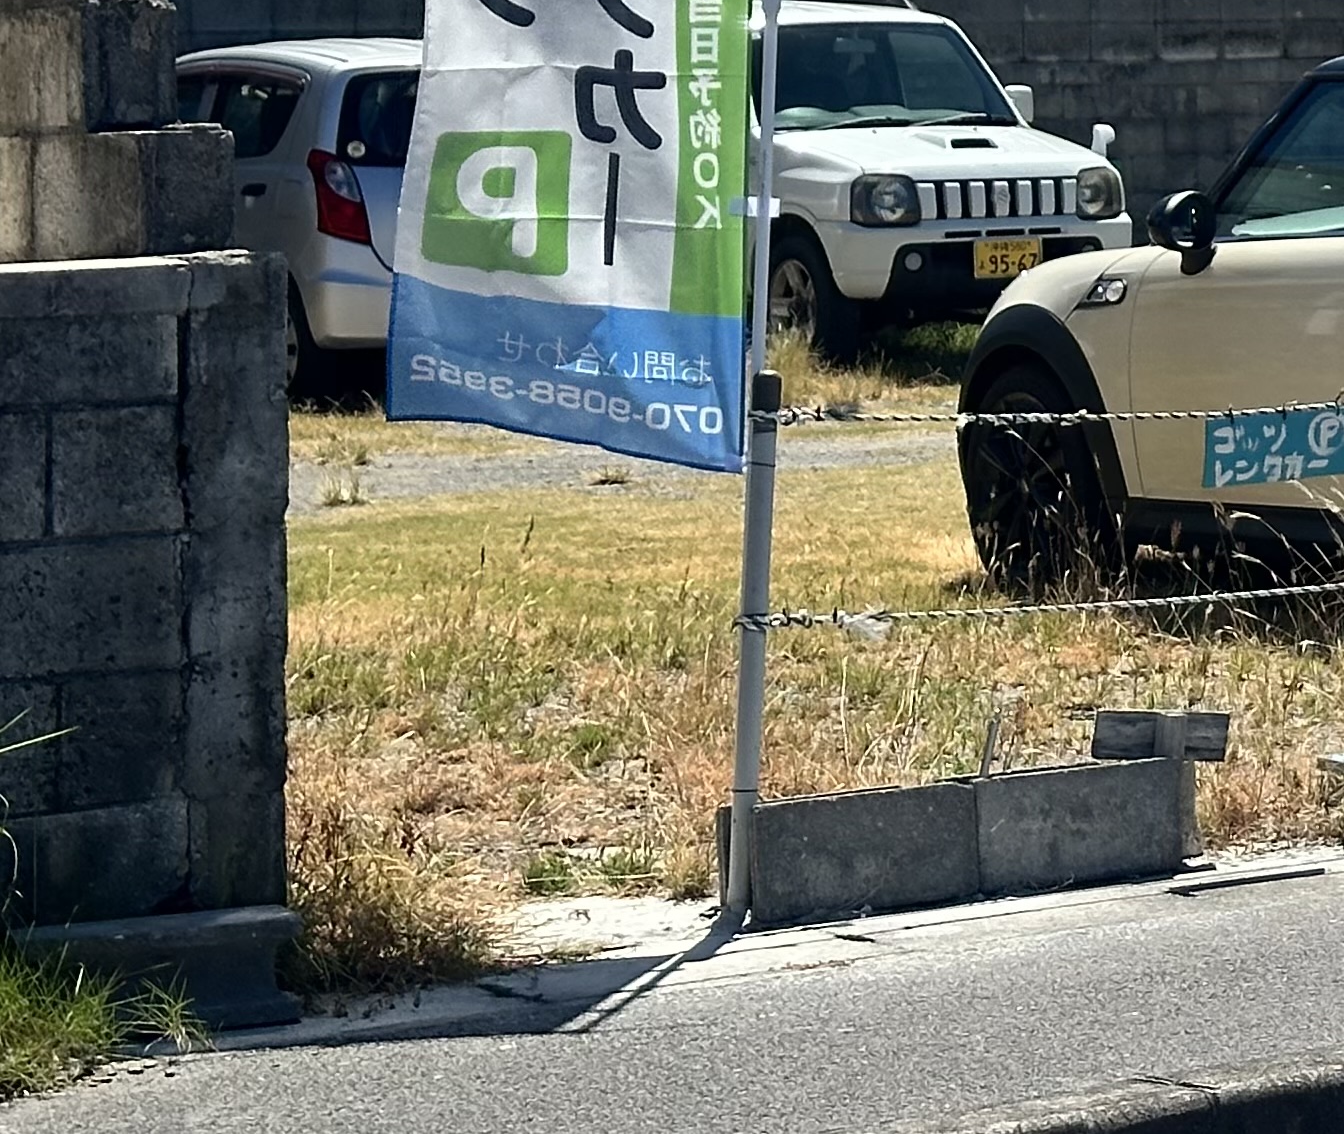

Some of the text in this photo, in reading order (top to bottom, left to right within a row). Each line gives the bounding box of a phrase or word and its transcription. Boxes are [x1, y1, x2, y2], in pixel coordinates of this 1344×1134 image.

[1214, 451, 1329, 488] レンタカー
